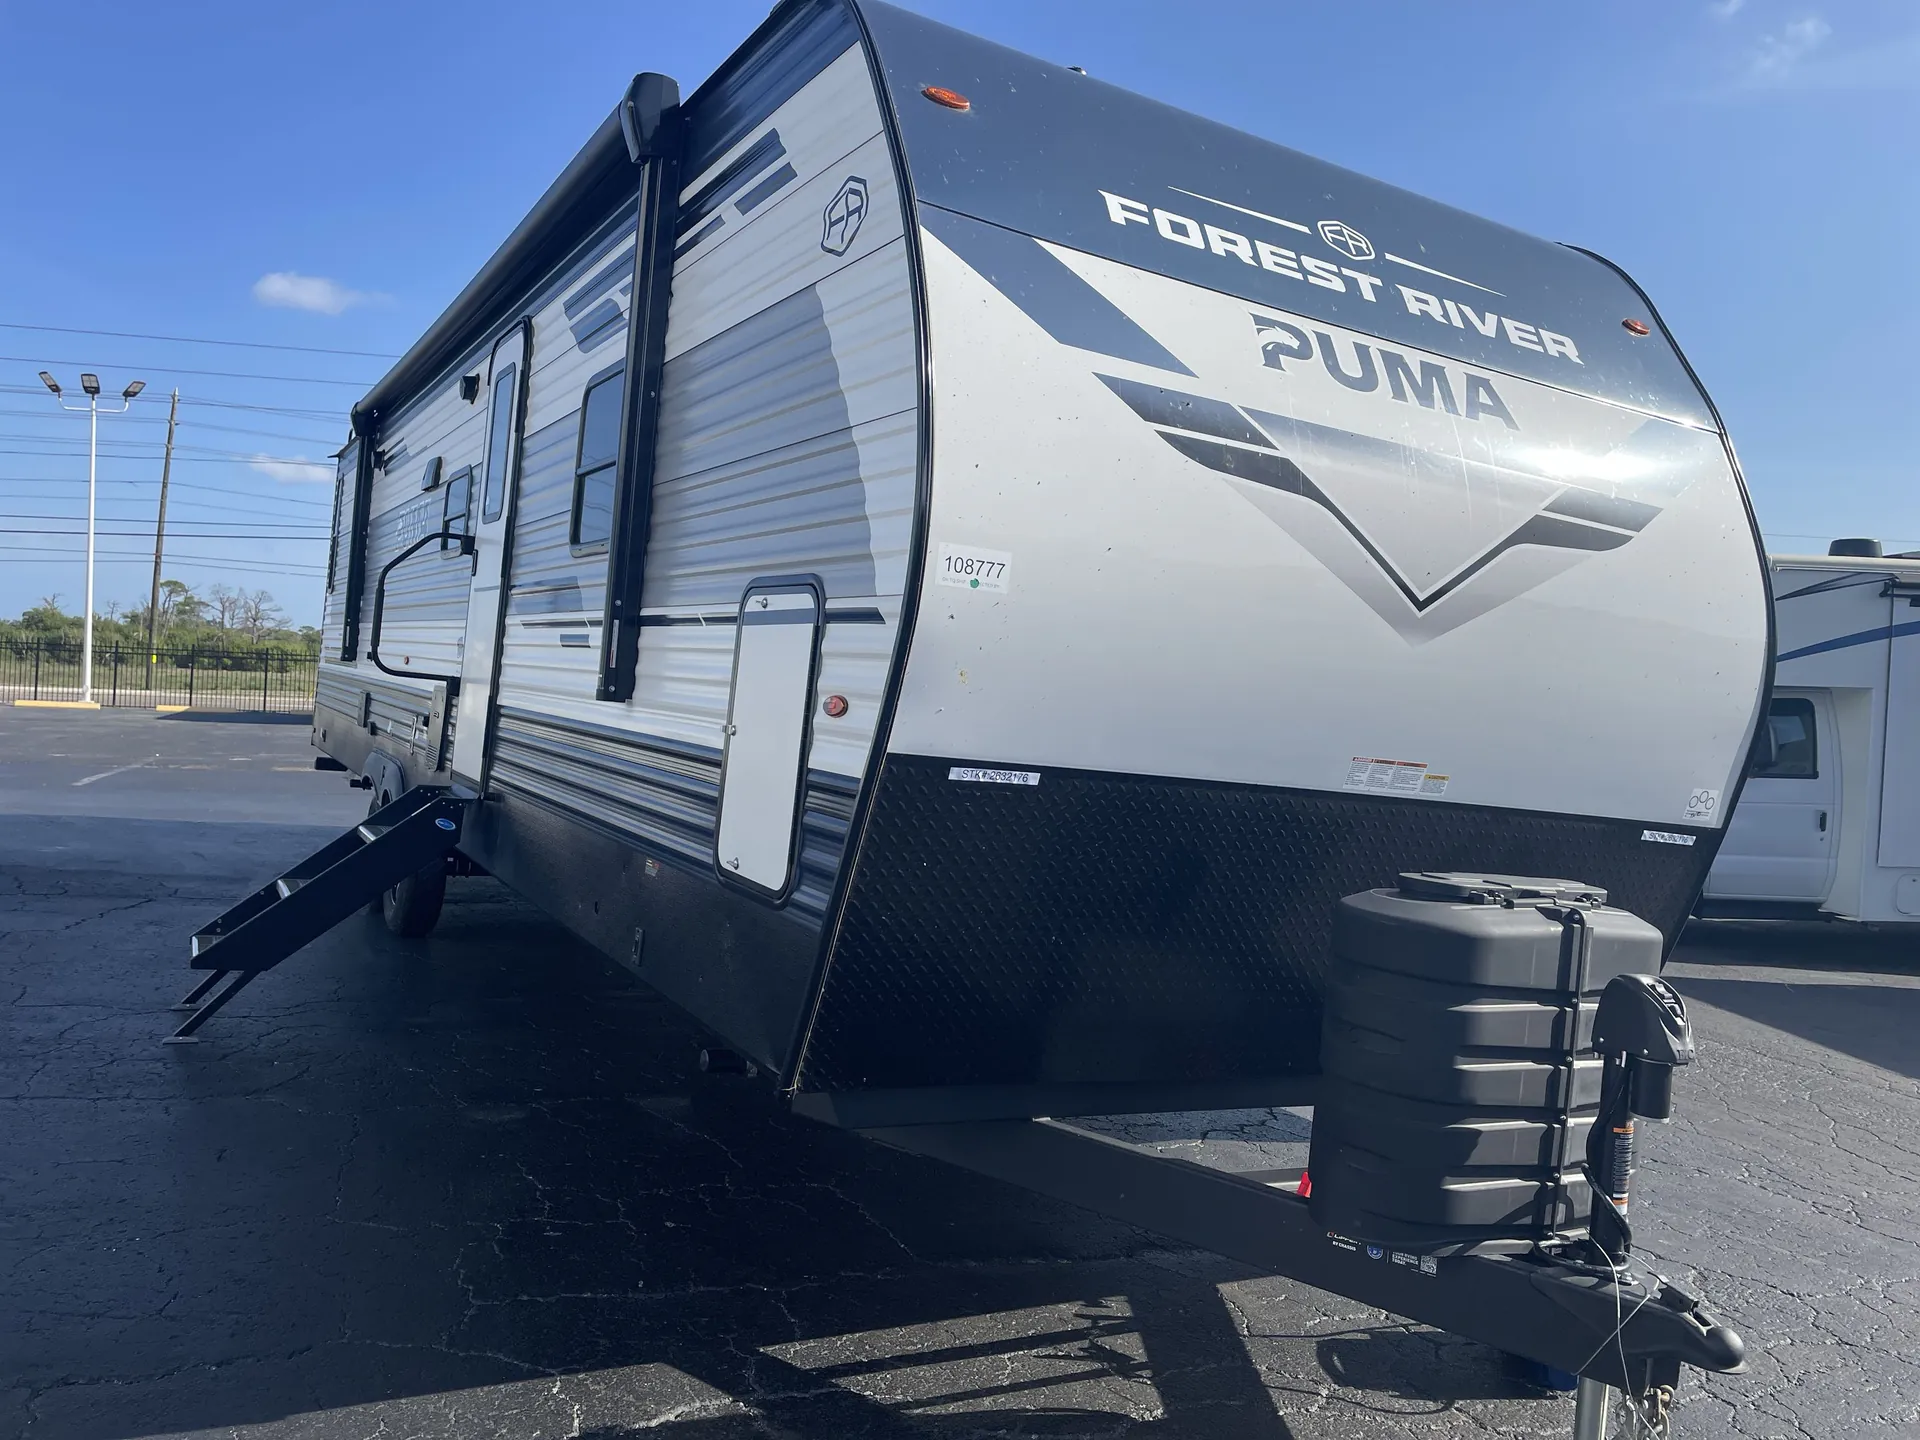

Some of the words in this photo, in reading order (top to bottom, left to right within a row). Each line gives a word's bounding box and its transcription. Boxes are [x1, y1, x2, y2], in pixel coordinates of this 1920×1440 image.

[1098, 189, 1383, 303] FOREST
[1396, 283, 1585, 365] RIVER
[1249, 312, 1521, 431] PUMA
[945, 555, 1006, 578] 108777
